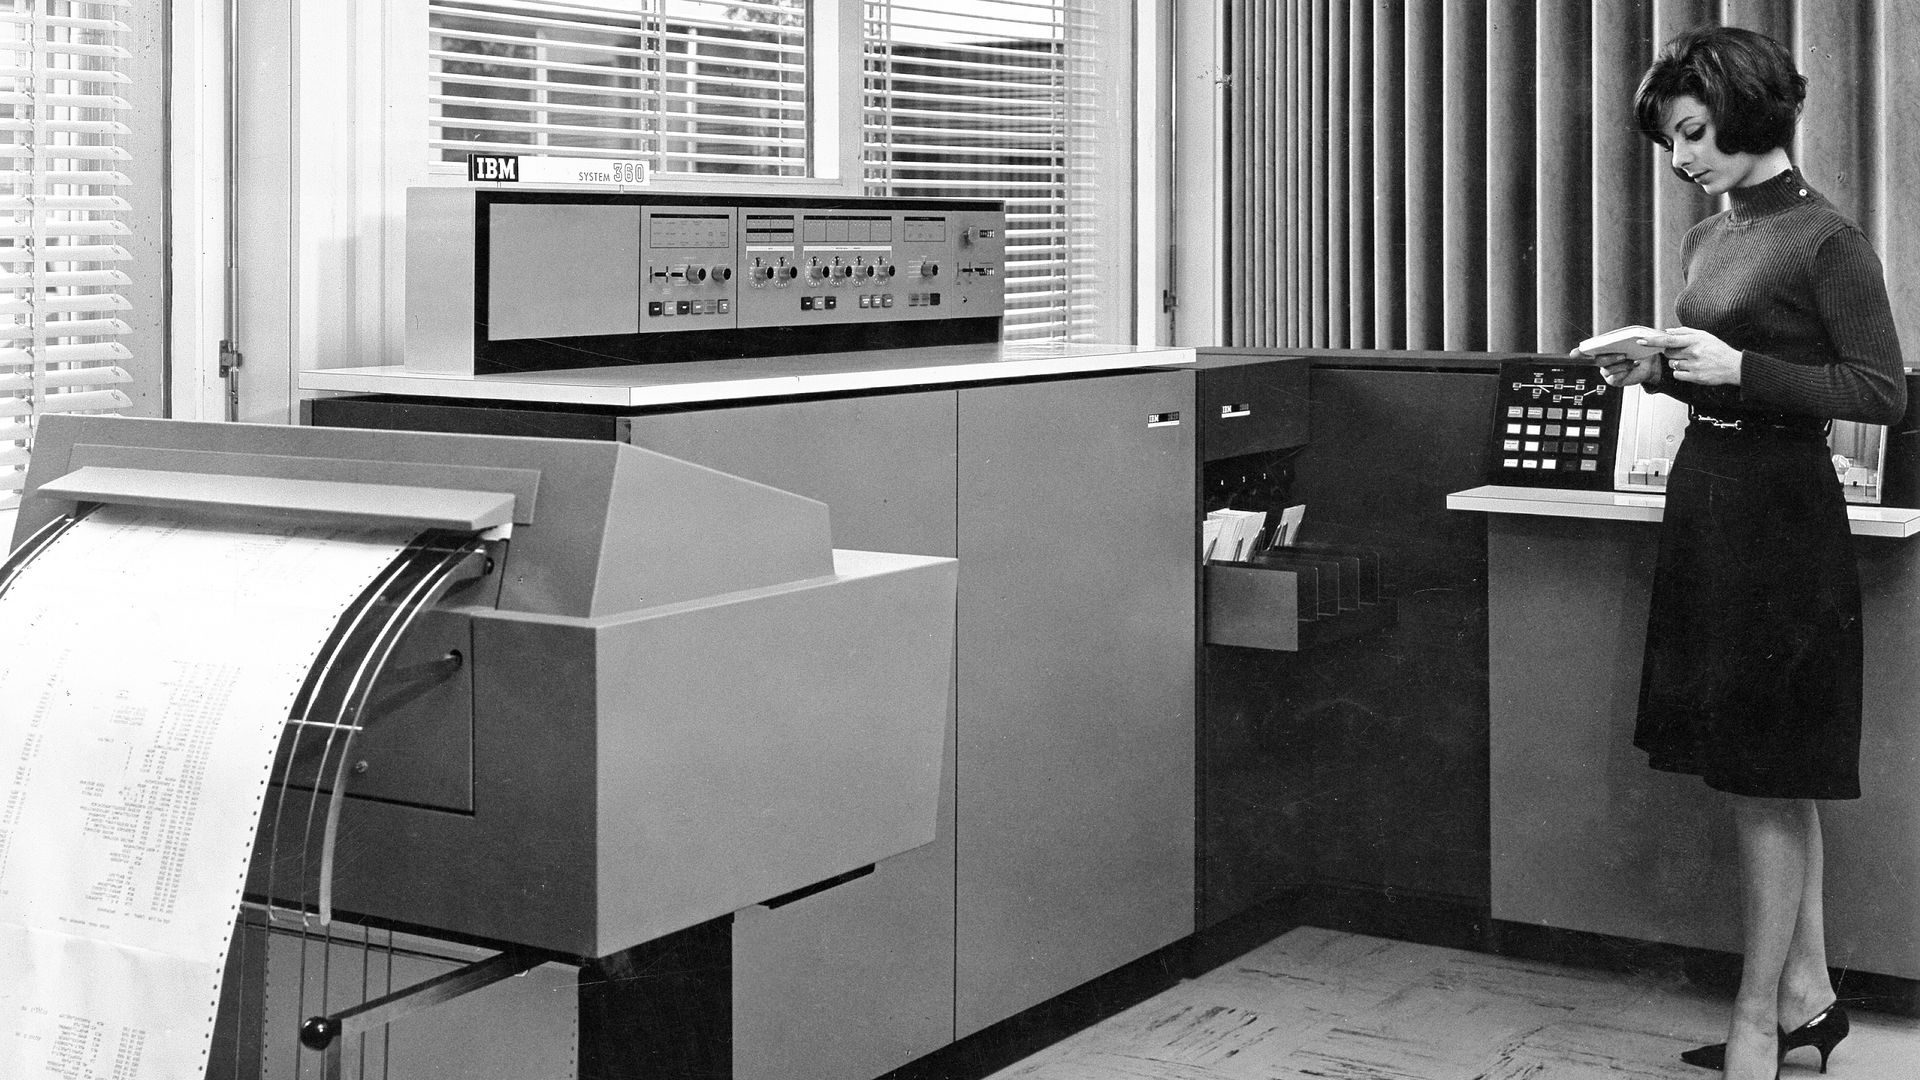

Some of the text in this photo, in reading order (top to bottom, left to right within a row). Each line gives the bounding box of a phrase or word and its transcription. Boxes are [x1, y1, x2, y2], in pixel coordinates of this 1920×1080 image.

[476, 157, 645, 183] IBM SYSTEM 360
[1149, 414, 1159, 422] IBM
